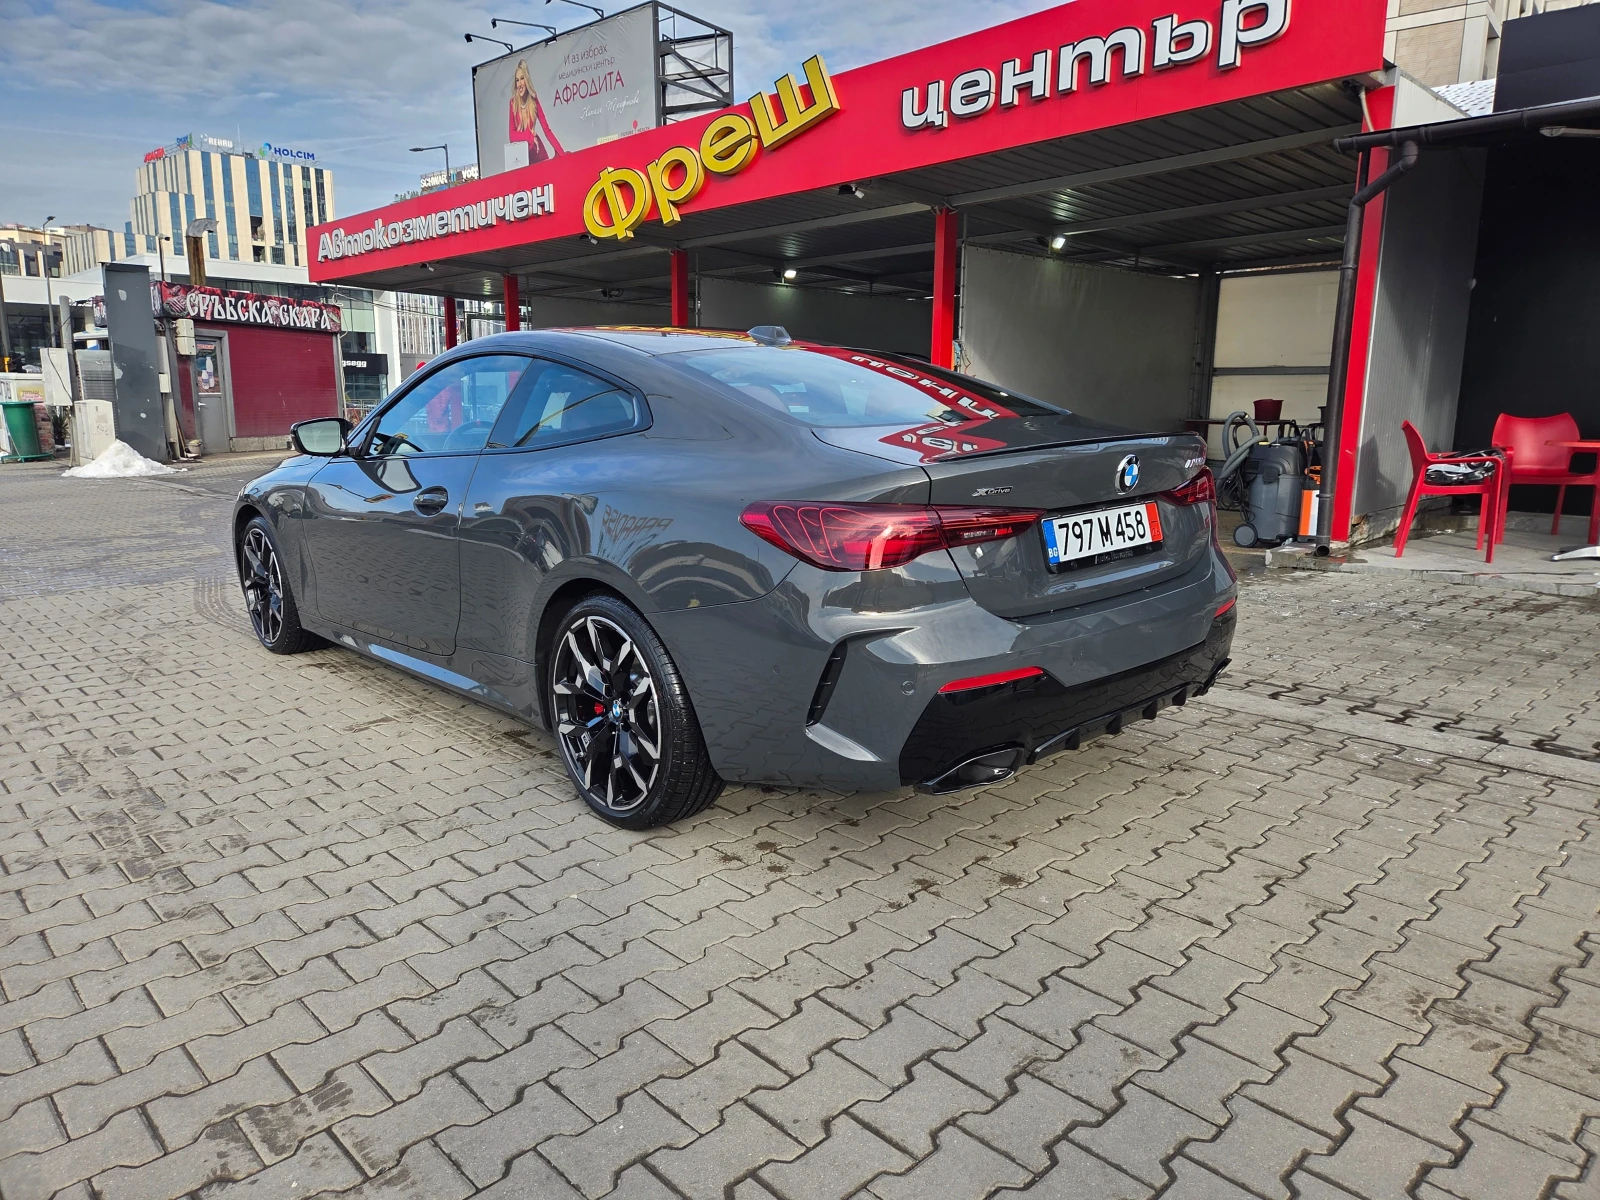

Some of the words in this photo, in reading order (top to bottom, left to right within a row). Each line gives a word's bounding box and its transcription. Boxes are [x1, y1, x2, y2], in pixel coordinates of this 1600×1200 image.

[563, 54, 570, 66] И
[572, 53, 580, 64] аз
[581, 44, 608, 60] избрах
[558, 64, 593, 80] медицински
[594, 56, 616, 71] център
[553, 70, 625, 107] АФРОДИТА
[317, 183, 555, 263] Автокозметичен
[583, 54, 840, 242] Фреш
[901, 0, 1291, 130] център
[273, 147, 315, 161] HOLCIM
[420, 173, 453, 188] SCHWAR
[186, 292, 274, 325] СРЪБСКА
[279, 304, 331, 330] СКАРА
[1058, 519, 1093, 556] 797
[1097, 515, 1113, 548] M
[1115, 510, 1146, 543] 458
[1047, 547, 1058, 558] BG
